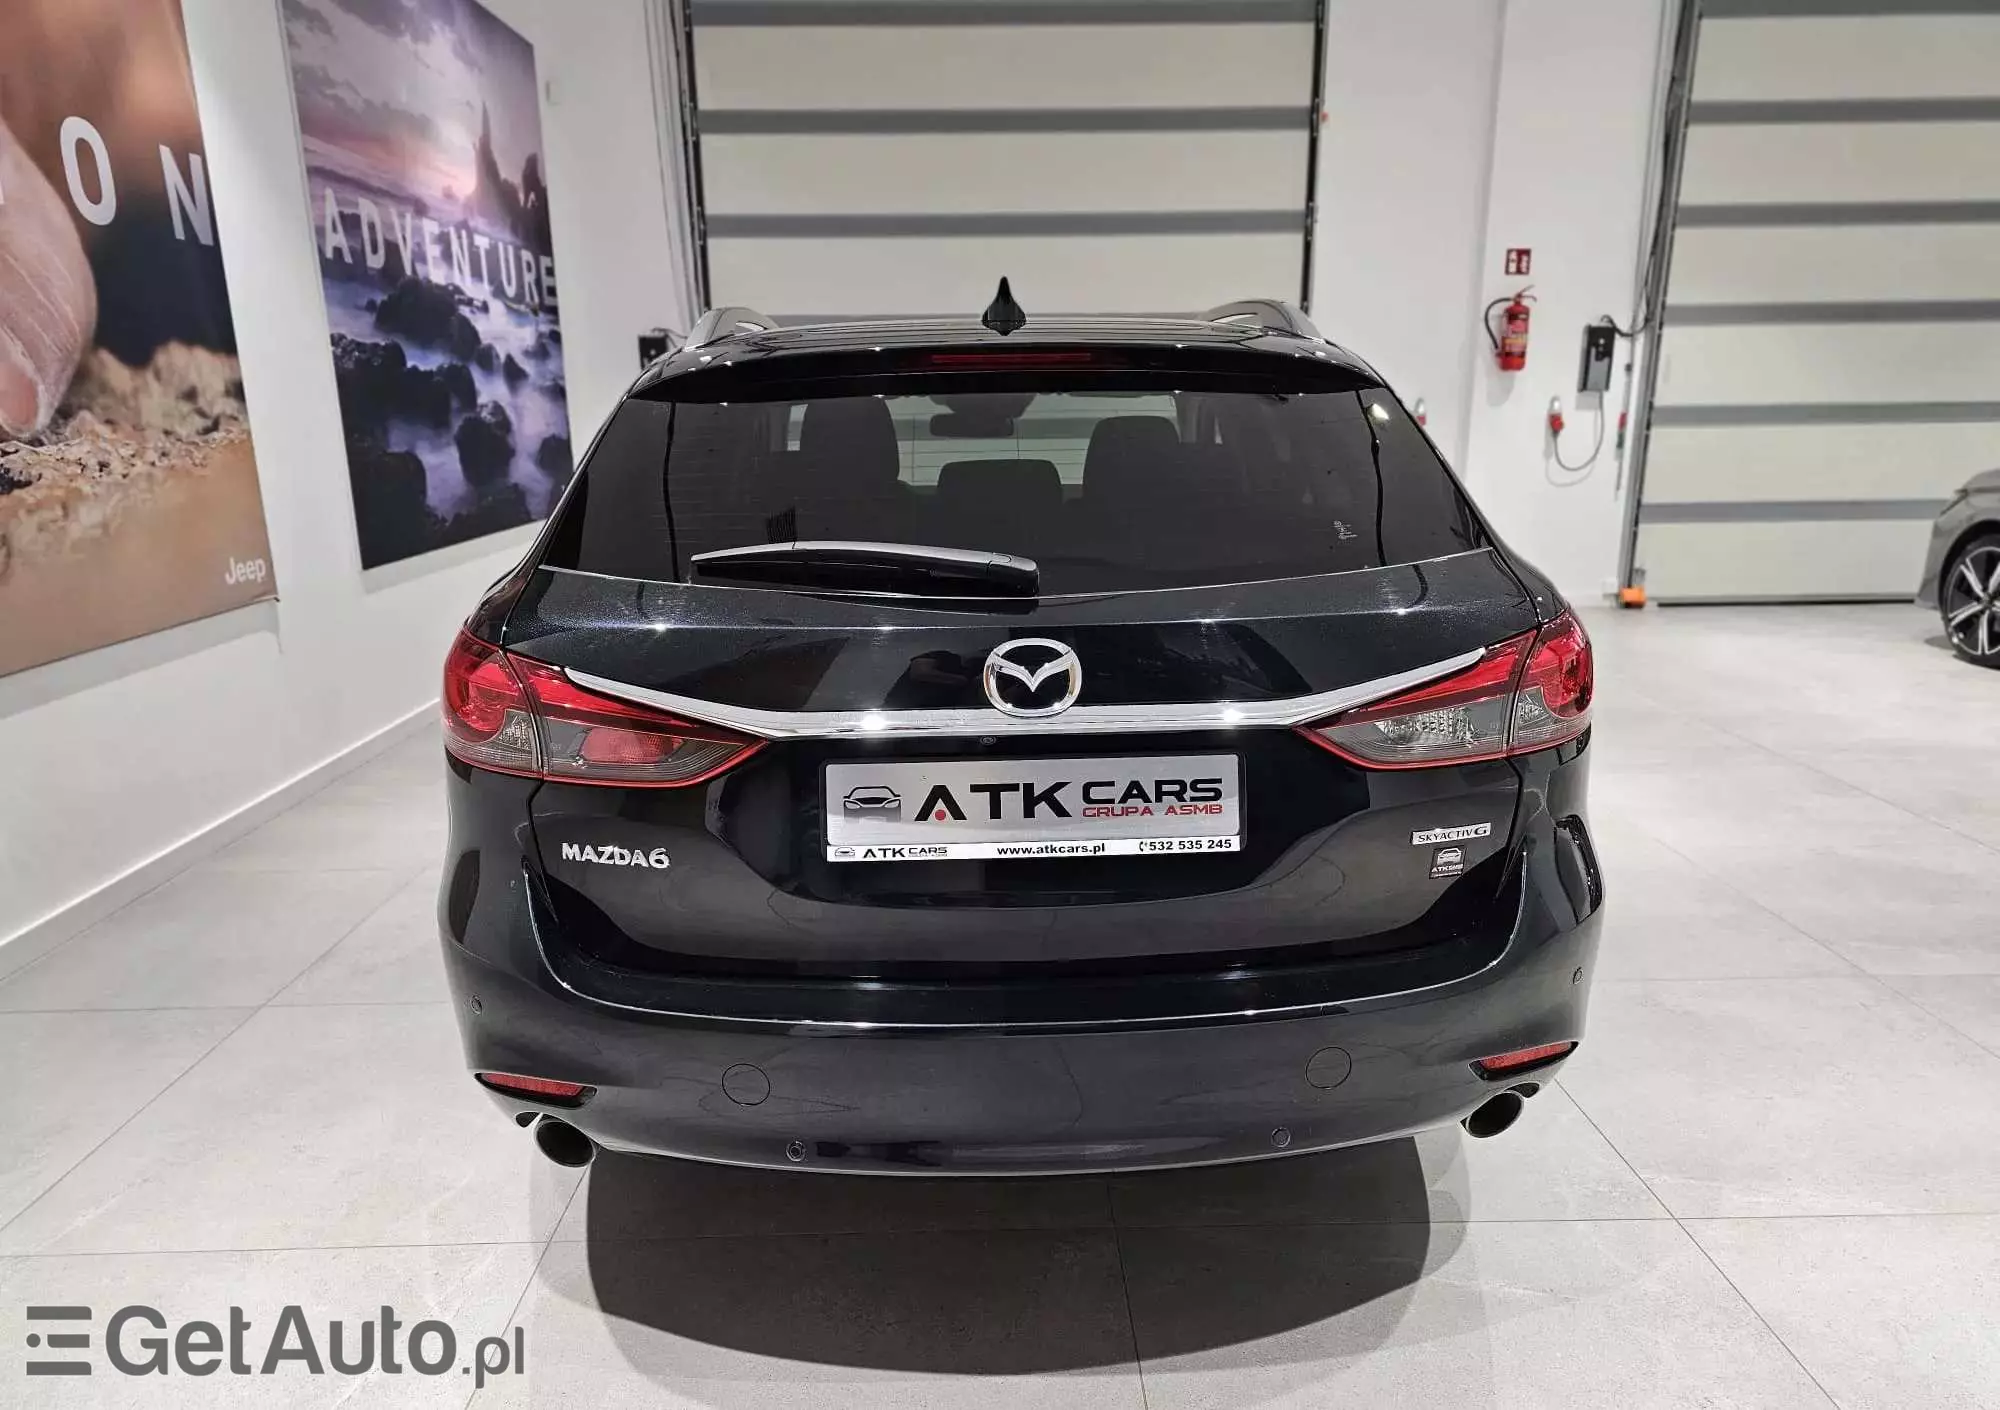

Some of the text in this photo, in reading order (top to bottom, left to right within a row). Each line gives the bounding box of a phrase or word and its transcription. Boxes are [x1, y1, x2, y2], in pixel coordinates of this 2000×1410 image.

[325, 186, 557, 309] ADVENTURE
[225, 557, 266, 585] Jeep
[914, 778, 1223, 822] ATK CARS
[1082, 803, 1223, 818] GRUPA ASMB
[997, 843, 1106, 856] www.atkcars.pl
[1149, 839, 1232, 851] 532 535 245
[863, 848, 905, 858] ATK
